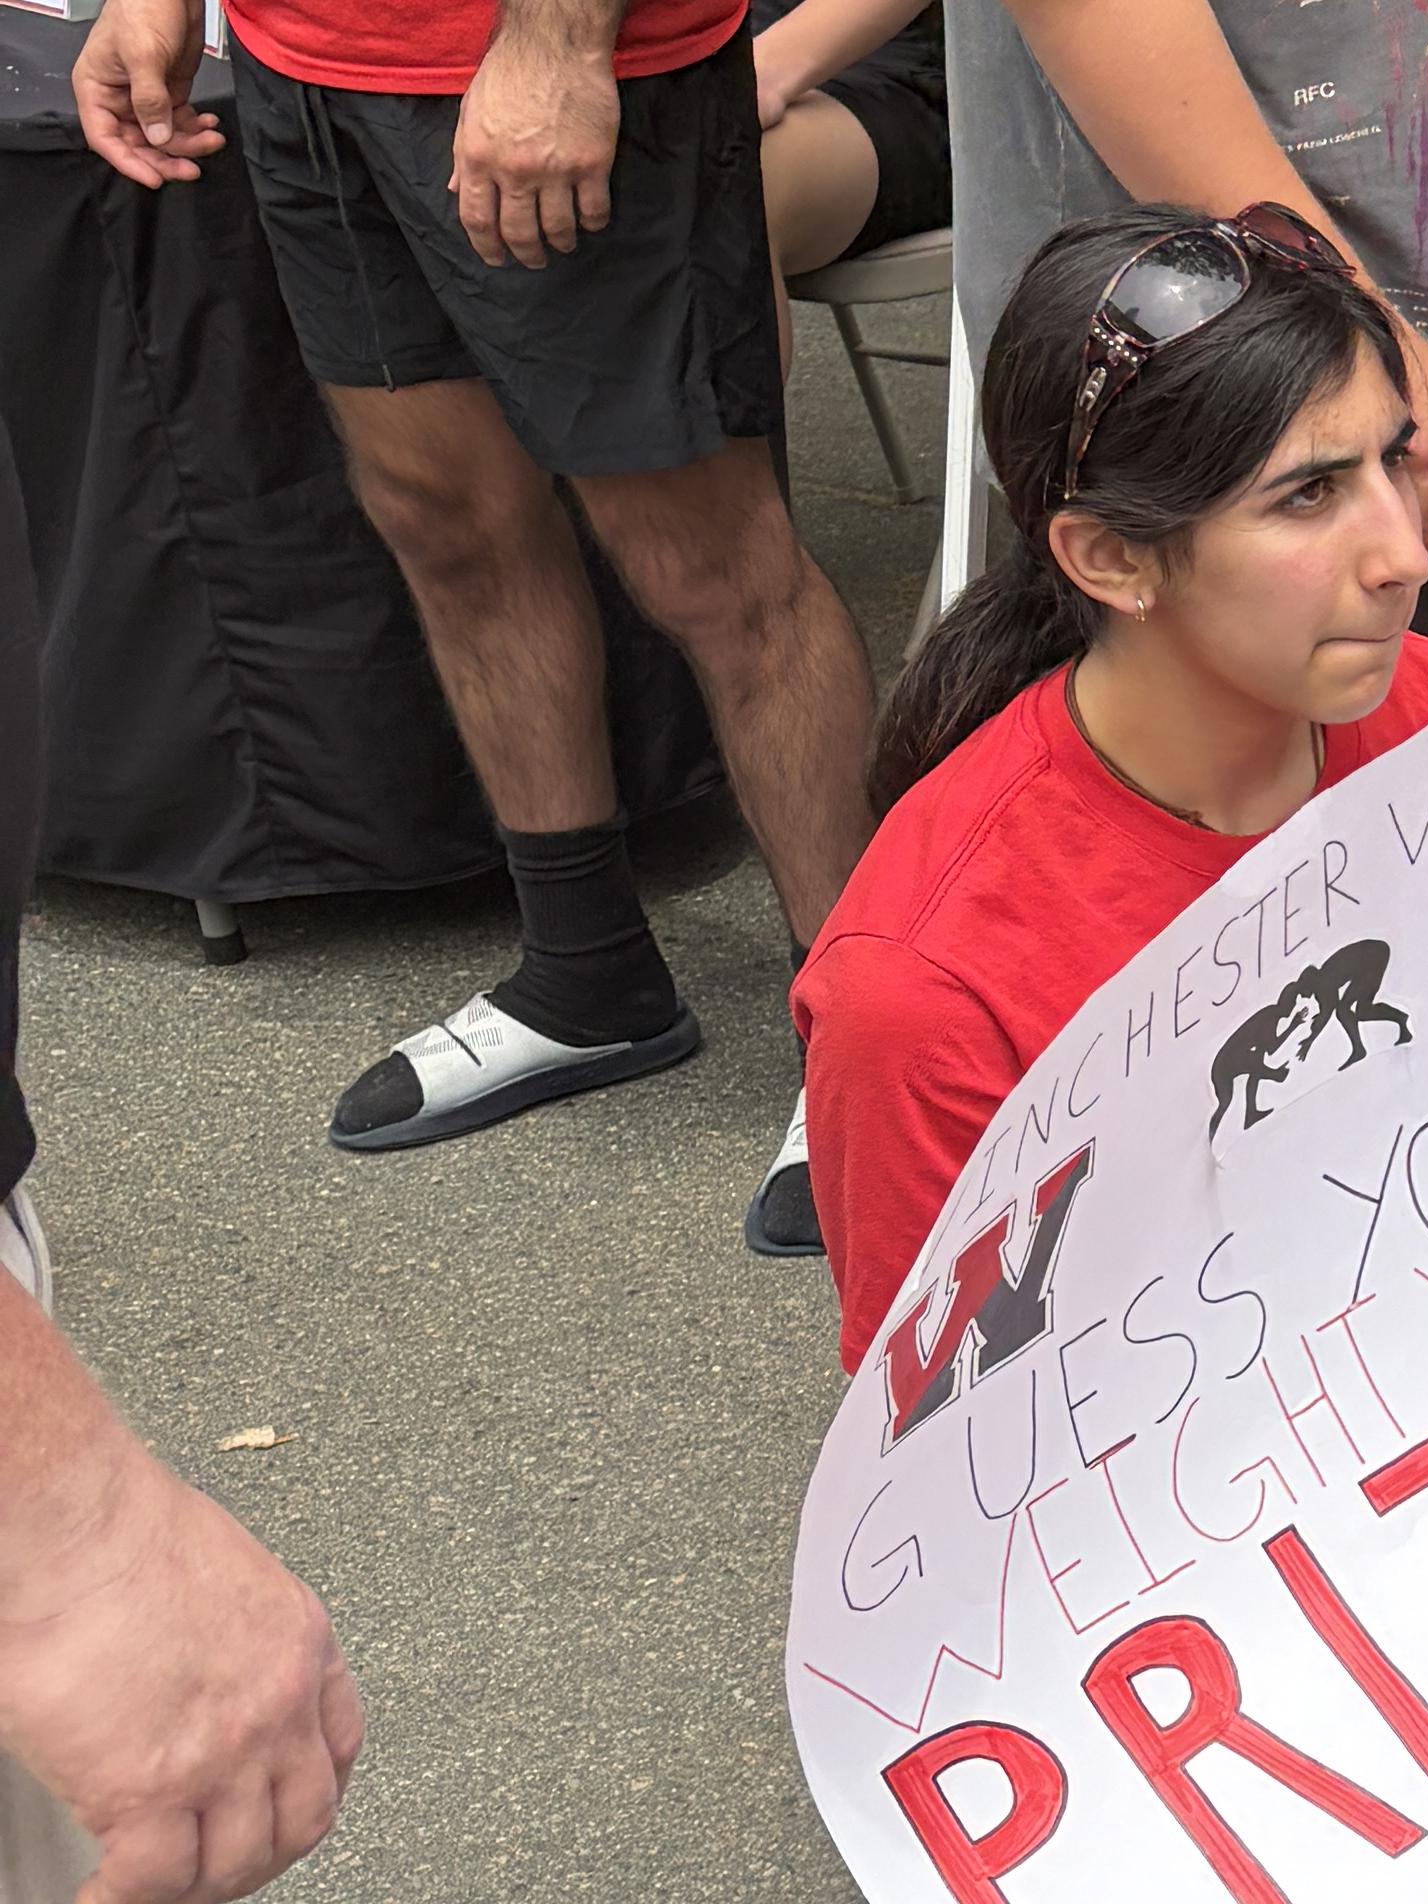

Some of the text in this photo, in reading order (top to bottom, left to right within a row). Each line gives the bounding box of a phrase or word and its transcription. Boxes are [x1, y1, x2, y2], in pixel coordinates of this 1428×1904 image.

[1293, 81, 1336, 107] RFC
[800, 1294, 1407, 1736] WEIGHT
[840, 1231, 1267, 1613] GUESS
